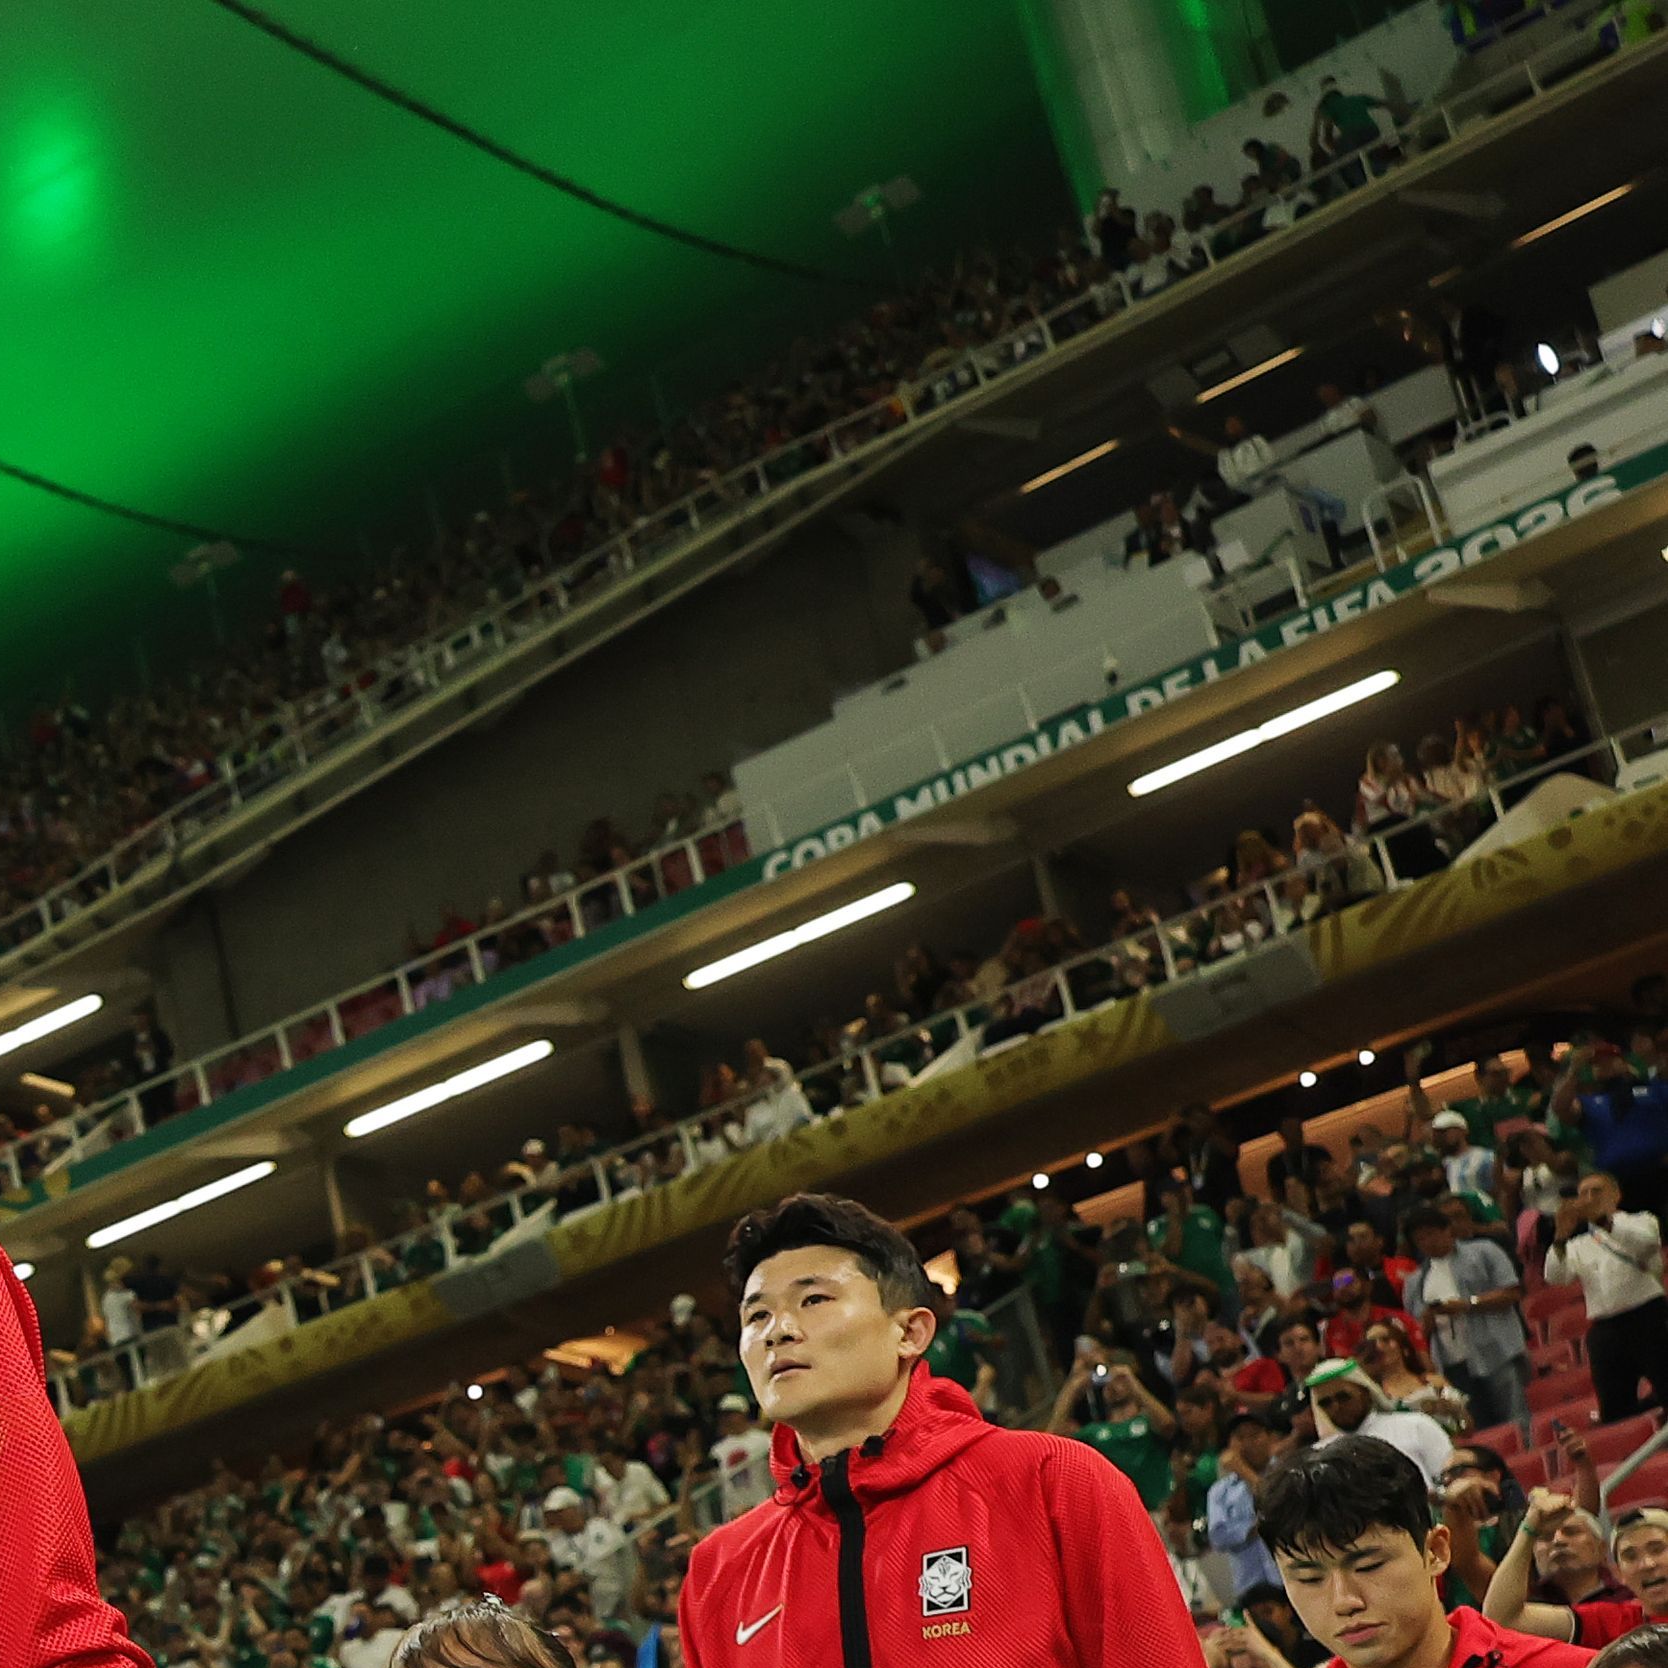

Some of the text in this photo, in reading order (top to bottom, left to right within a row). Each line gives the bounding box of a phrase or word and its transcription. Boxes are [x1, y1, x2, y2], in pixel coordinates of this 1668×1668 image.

[1280, 578, 1399, 649] FIFA
[1412, 474, 1624, 587] 2026
[921, 1621, 971, 1640] KOREA
